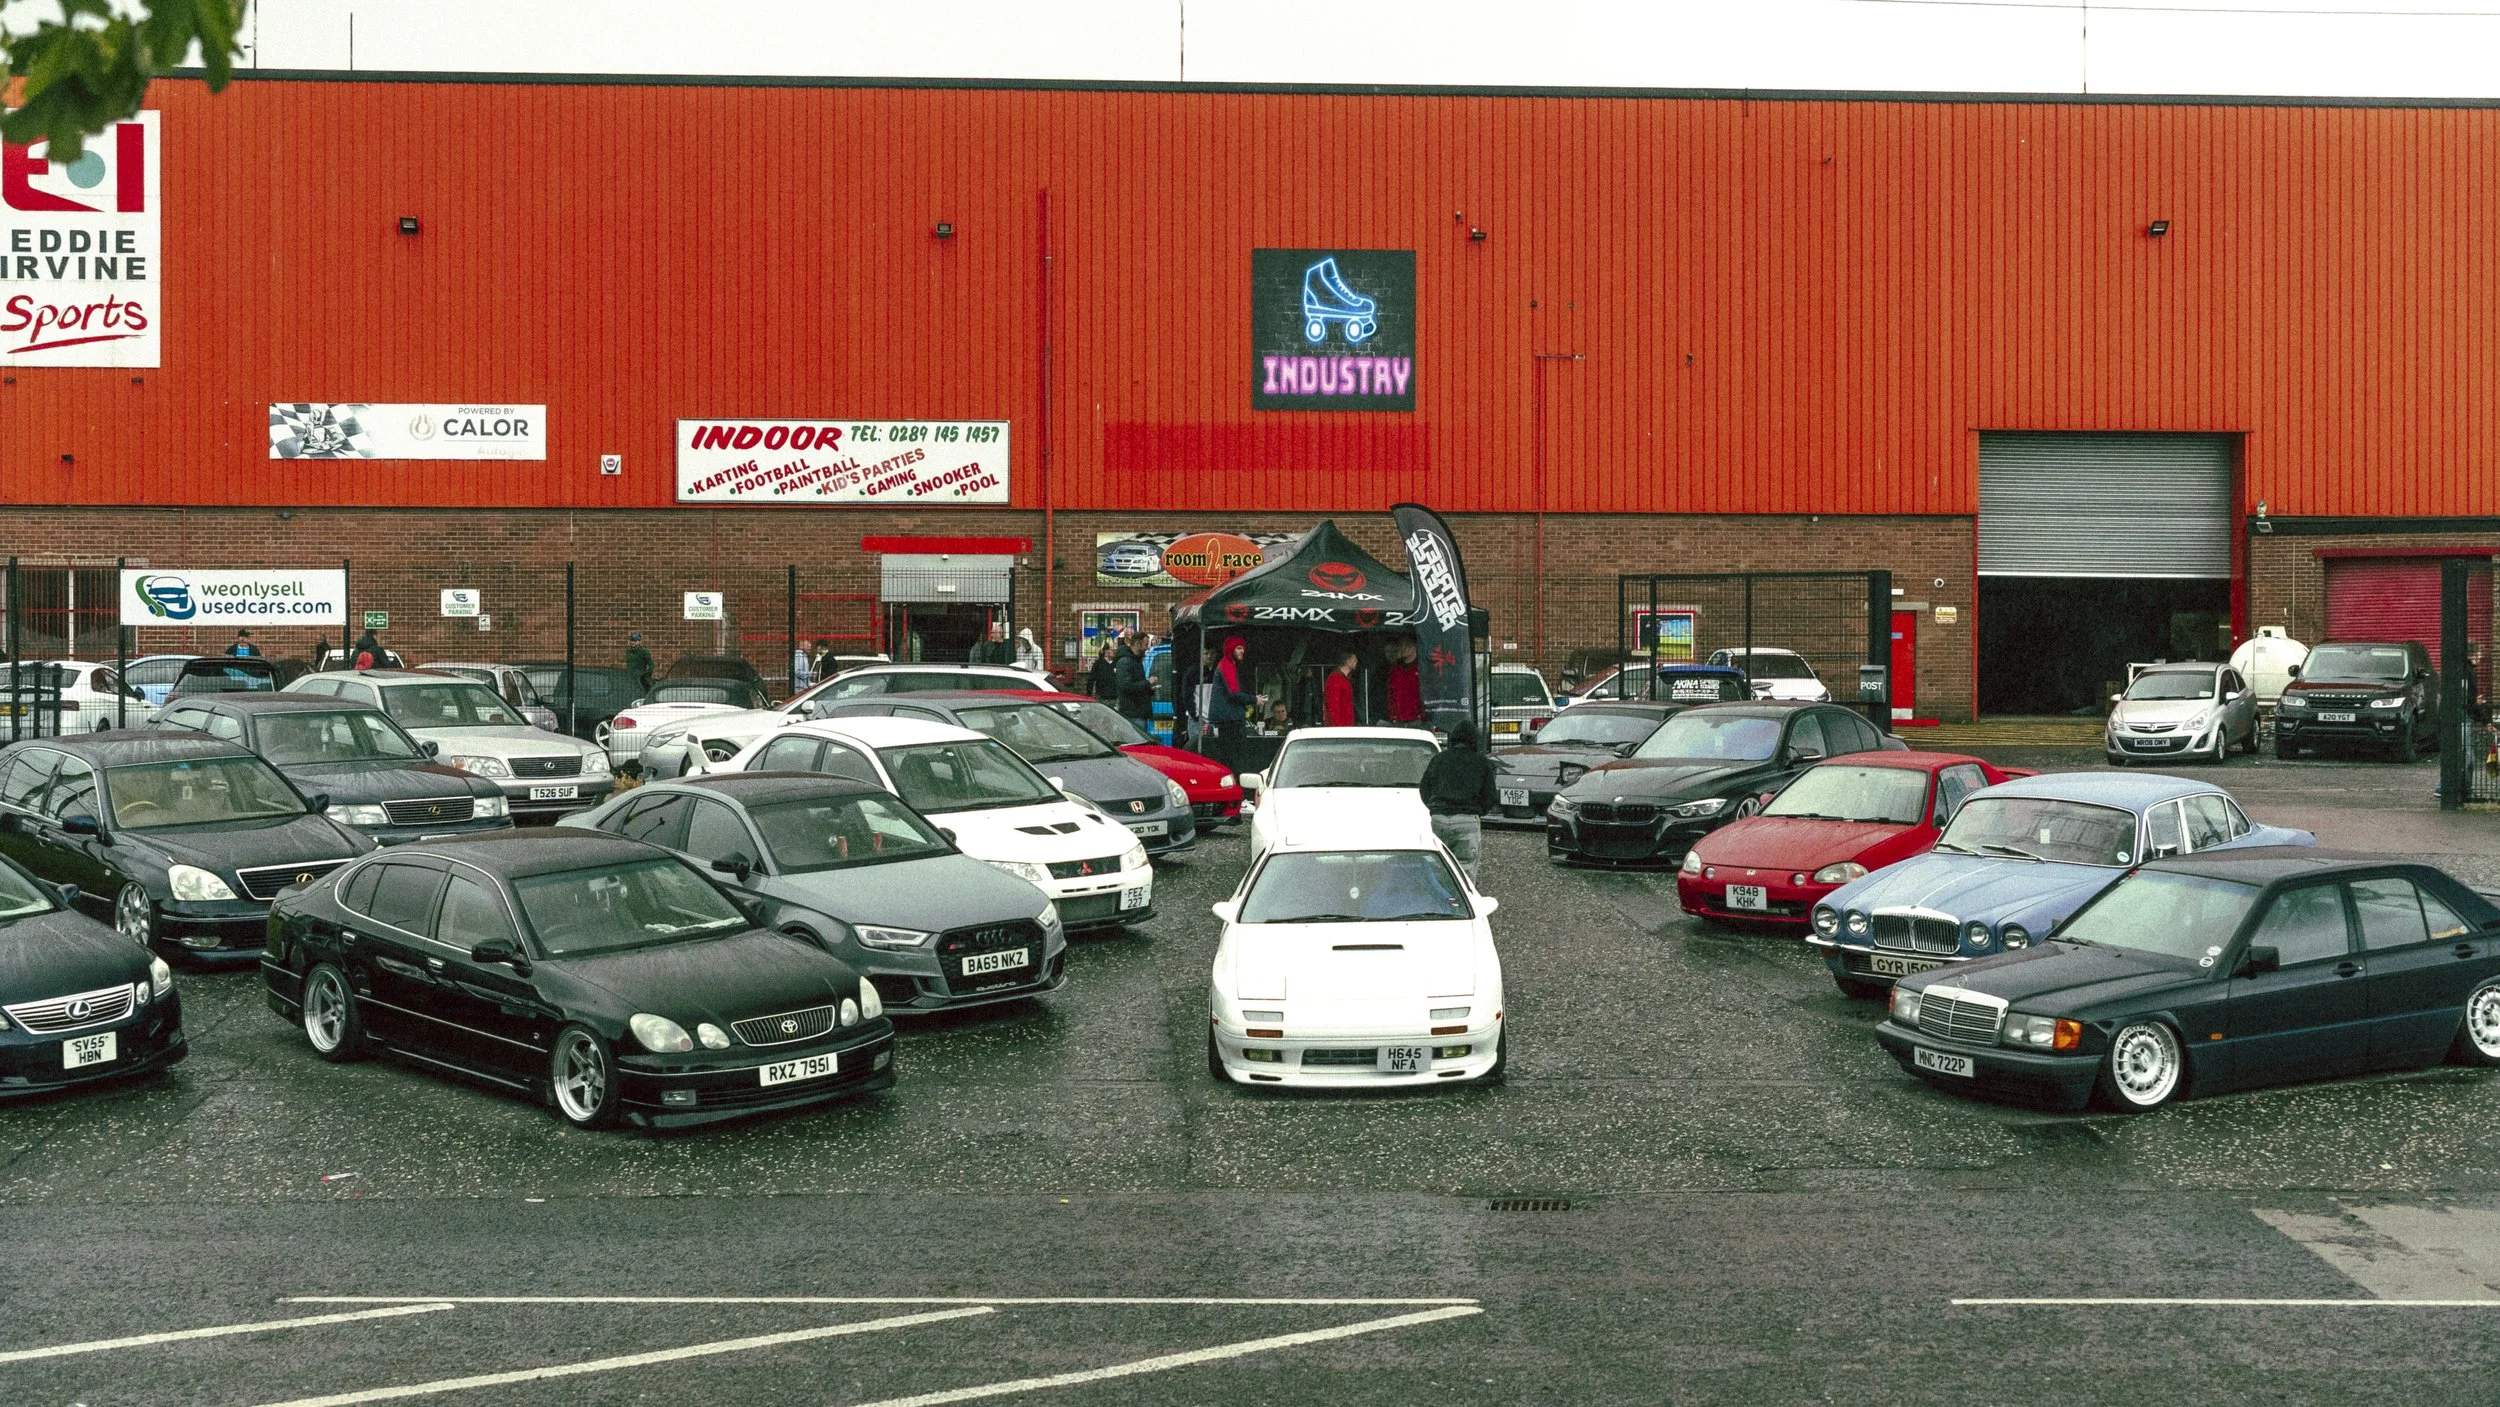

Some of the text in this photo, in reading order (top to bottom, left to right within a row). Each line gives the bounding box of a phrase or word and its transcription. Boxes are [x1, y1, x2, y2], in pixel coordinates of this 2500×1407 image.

[12, 229, 135, 253] EDDIE
[0, 256, 146, 280] IRVINE
[0, 294, 148, 343] Sports
[1263, 356, 1411, 394] INDUSTRY
[443, 419, 529, 436] CALOR
[851, 425, 999, 443] TEL: 0289 145 1457
[691, 426, 842, 452] INDOOR
[693, 459, 759, 494] KARTING
[735, 458, 810, 495] FOOTBALL
[779, 457, 860, 495] PAINTBALL
[821, 448, 925, 495] KID'S PARTIES
[913, 462, 982, 496] SNOOKER
[866, 468, 917, 496] GAMING
[960, 473, 1000, 496] POOL
[1164, 553, 1208, 567] room
[1222, 553, 1262, 568] race
[201, 581, 305, 599] weonlysell
[1301, 589, 1385, 601] 24MX
[202, 599, 332, 614] usedcars.com
[1253, 607, 1335, 622] 24MX
[1861, 682, 1882, 690] POST
[535, 787, 574, 798] T526 SUF
[1504, 789, 1524, 798] K462
[1128, 887, 1143, 898] FEZ
[1732, 886, 1758, 896] K948
[1128, 897, 1142, 908] 227
[1736, 896, 1755, 907] KHK
[968, 952, 1023, 972] BA69 NKZ
[1877, 959, 1904, 973] GYR
[75, 1036, 104, 1051] SV55
[79, 1049, 101, 1063] HBN
[1388, 1047, 1422, 1058] H645
[1919, 1050, 1965, 1072] MNC 722P
[769, 1057, 829, 1081] RXZ 7951
[1392, 1059, 1416, 1070] NFA
